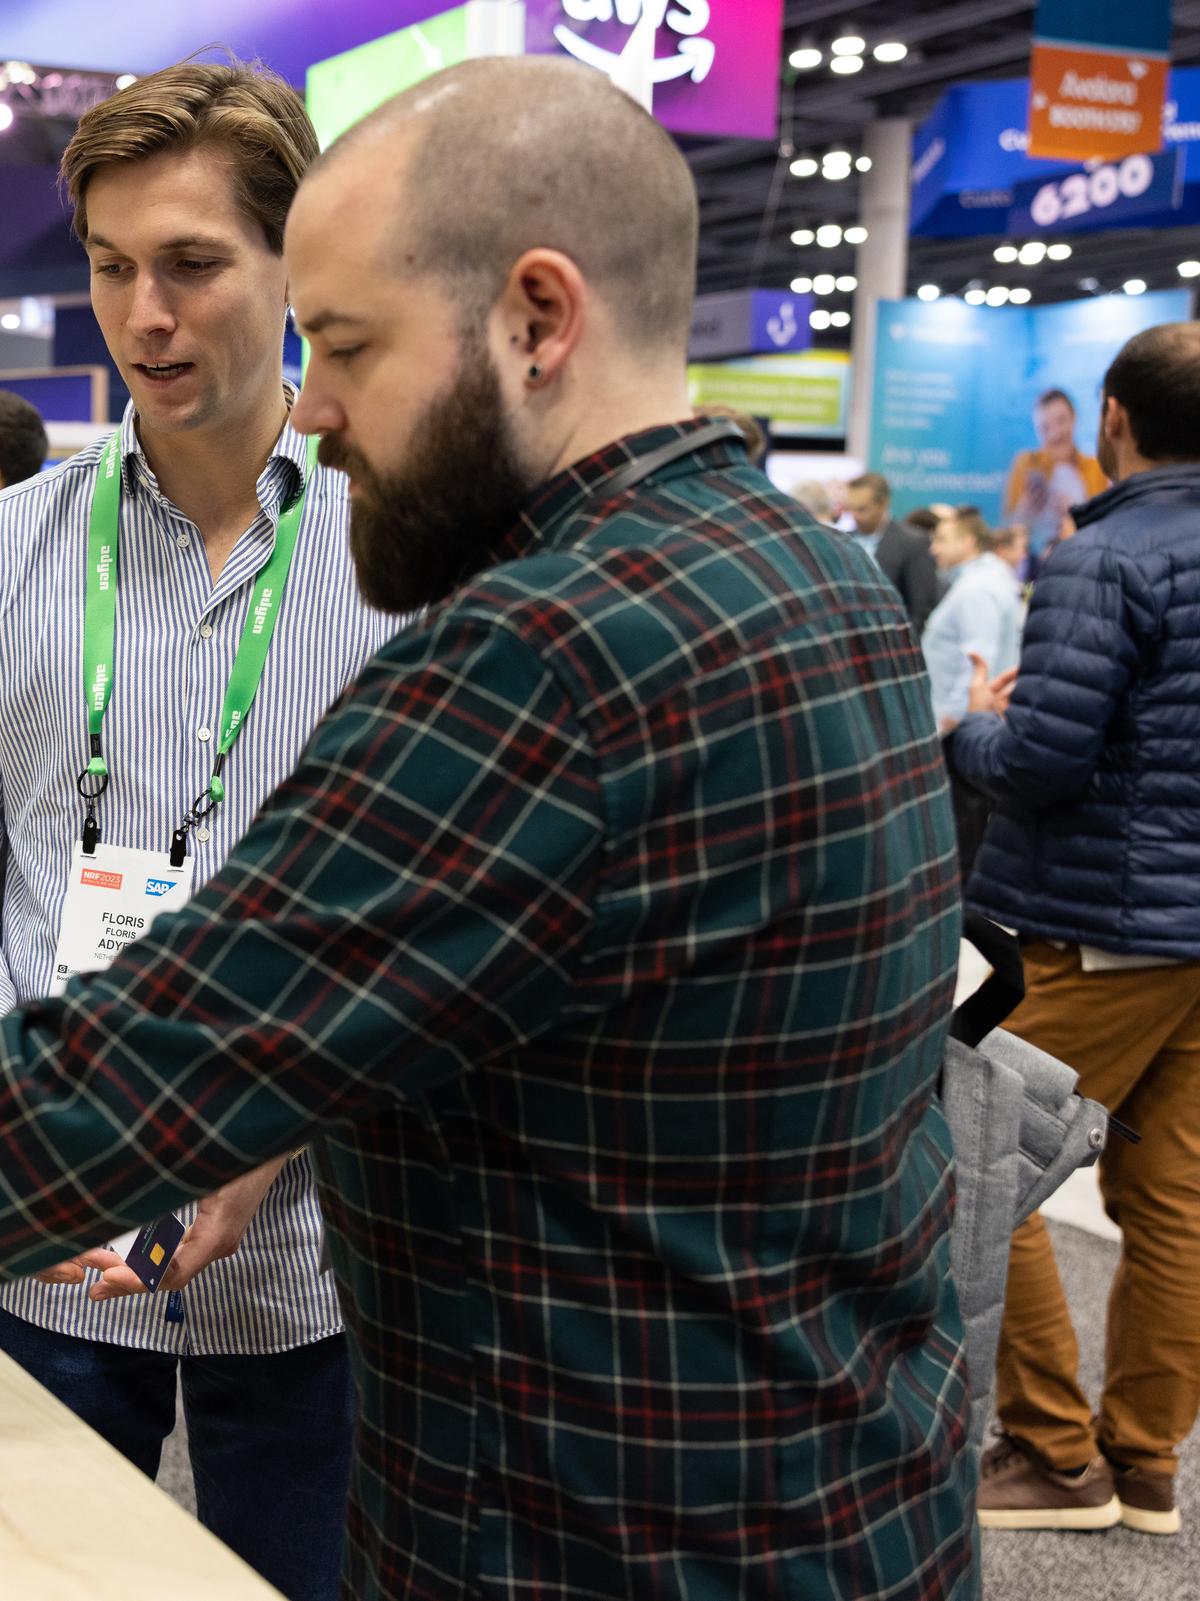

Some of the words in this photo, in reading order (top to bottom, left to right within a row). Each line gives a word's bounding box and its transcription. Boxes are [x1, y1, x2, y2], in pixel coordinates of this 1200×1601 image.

[1030, 154, 1155, 226] 6200
[96, 545, 113, 591] adyen
[252, 588, 273, 634] adyen
[92, 663, 109, 711] adyen
[146, 881, 170, 894] SAP
[101, 912, 145, 928] FLORIS
[105, 927, 137, 940] FLORIS
[97, 938, 131, 951] ADYE
[94, 952, 115, 961] NETHE
